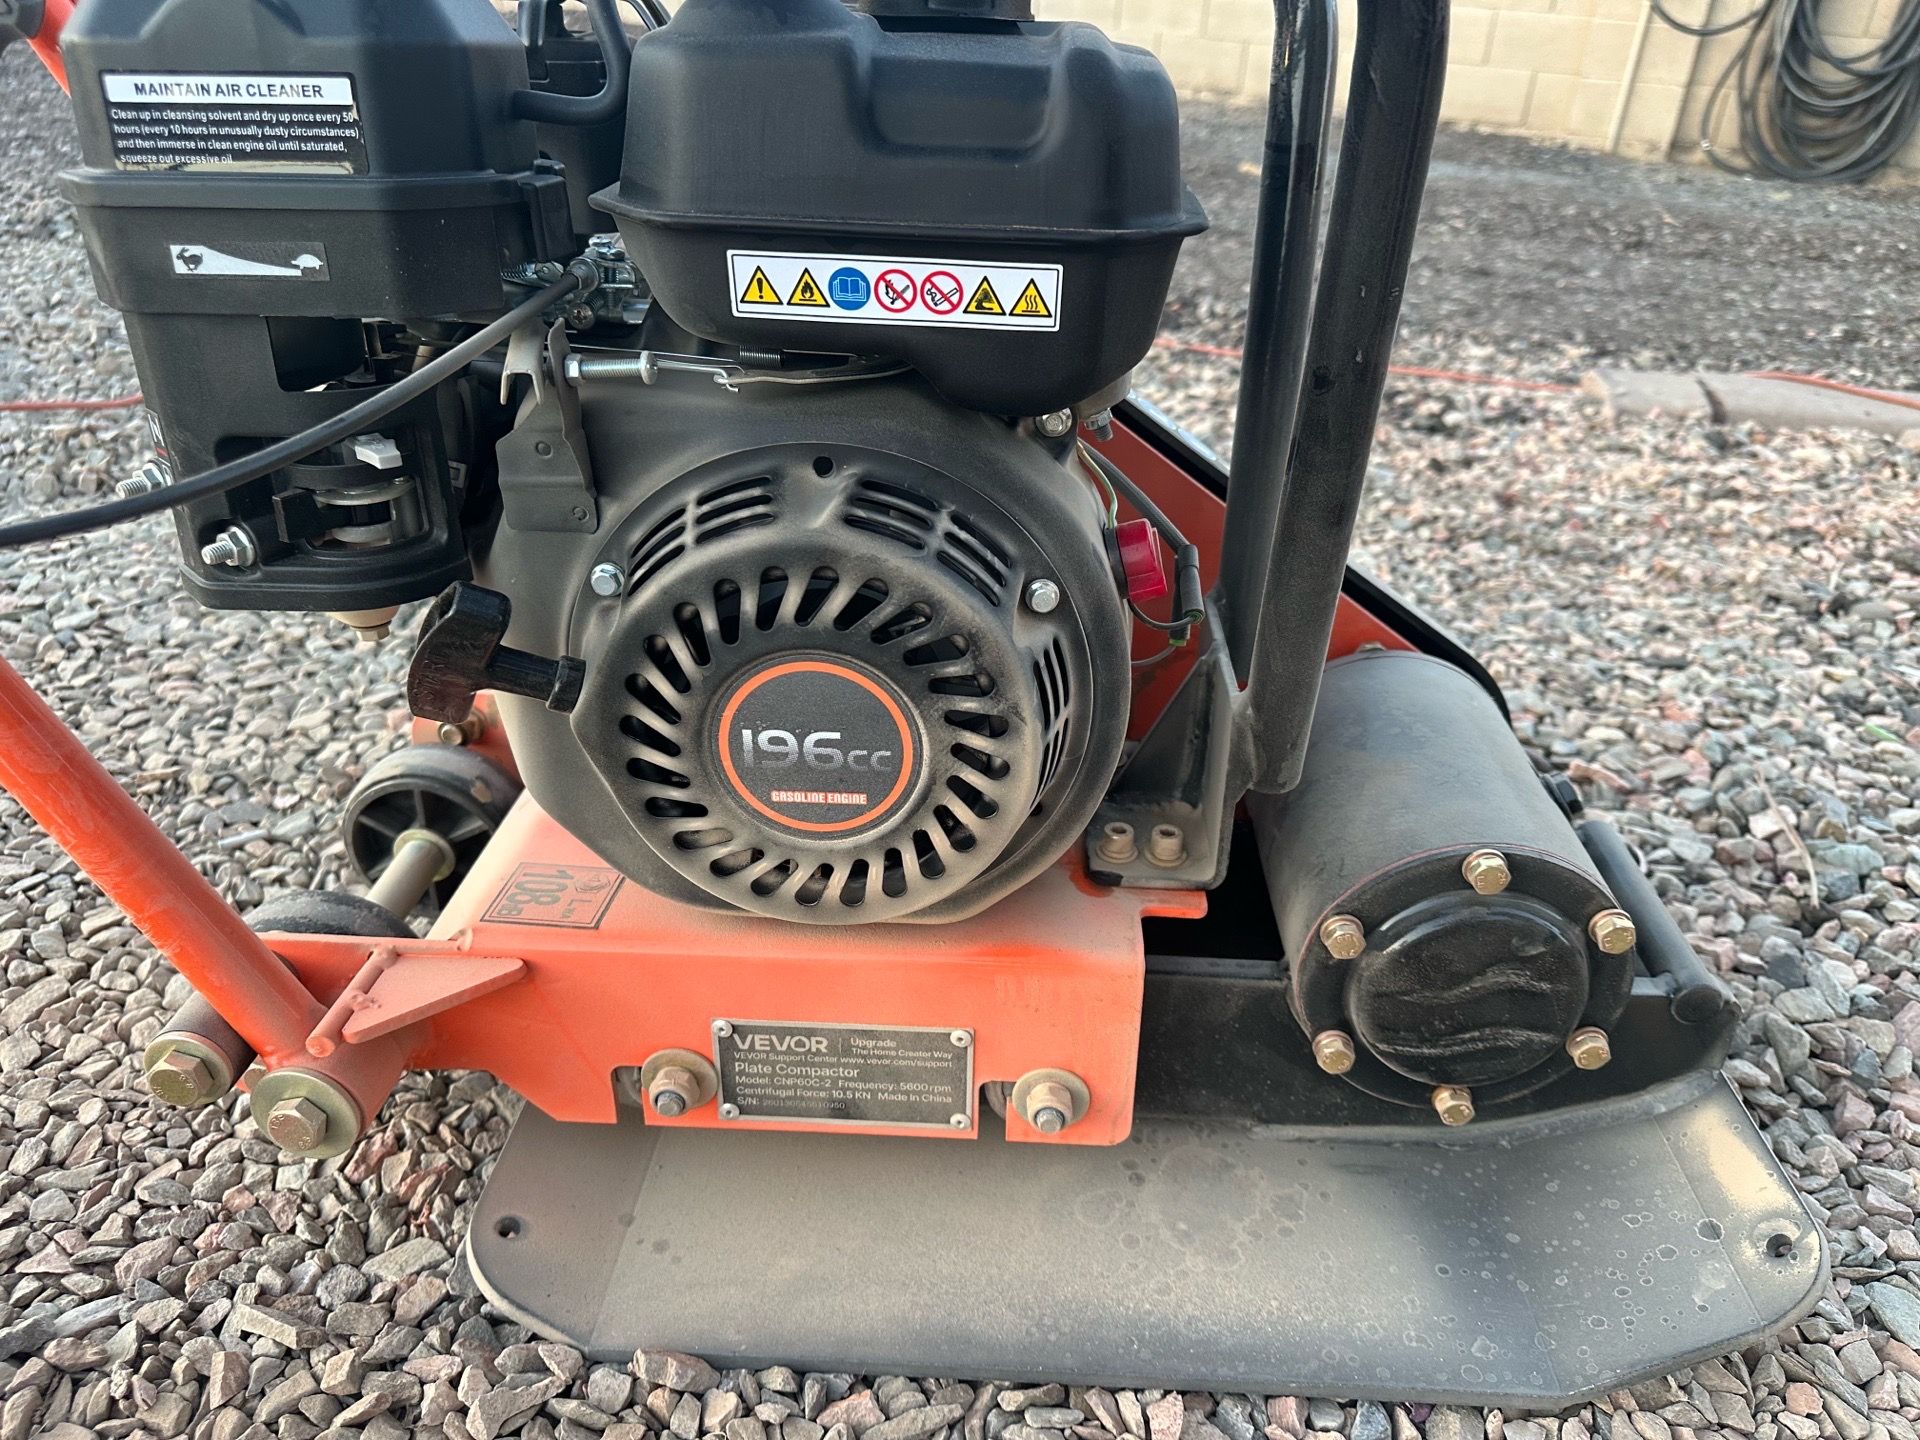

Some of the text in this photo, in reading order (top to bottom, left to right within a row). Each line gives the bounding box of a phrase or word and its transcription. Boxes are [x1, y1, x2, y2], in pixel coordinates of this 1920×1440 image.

[134, 83, 324, 98] MAINTAIN AIR CLEANER
[111, 109, 354, 125] Clean up in cleansing solvent and dry up once every 50
[113, 124, 359, 139] hours (every 10 hours in unusually dusty circumstances)
[117, 139, 348, 153] and then immerse in clean engine oil until saturated,
[120, 154, 157, 164] squeeze
[158, 153, 174, 163] out
[175, 154, 220, 164] excessive
[741, 729, 891, 771] 196cc
[771, 790, 867, 805] GASOLINE ENGINE
[733, 1033, 828, 1053] VEVOR
[850, 1037, 897, 1048] Upgrade
[734, 1051, 952, 1068] VEVOR Support Center www.vevor.com/support
[851, 1047, 953, 1060] The Home Creator Way
[734, 1061, 860, 1078] Plate Compactor
[735, 1075, 952, 1094] Model: CNP60C-2 Frequency: 5600 rpm
[736, 1086, 795, 1098] Centrifugal
[797, 1089, 829, 1098] Force:
[832, 1090, 853, 1099] 10.5
[855, 1091, 871, 1100] KN
[878, 1092, 908, 1101] Made
[921, 1094, 952, 1103] China
[737, 1096, 760, 1106] S/N:
